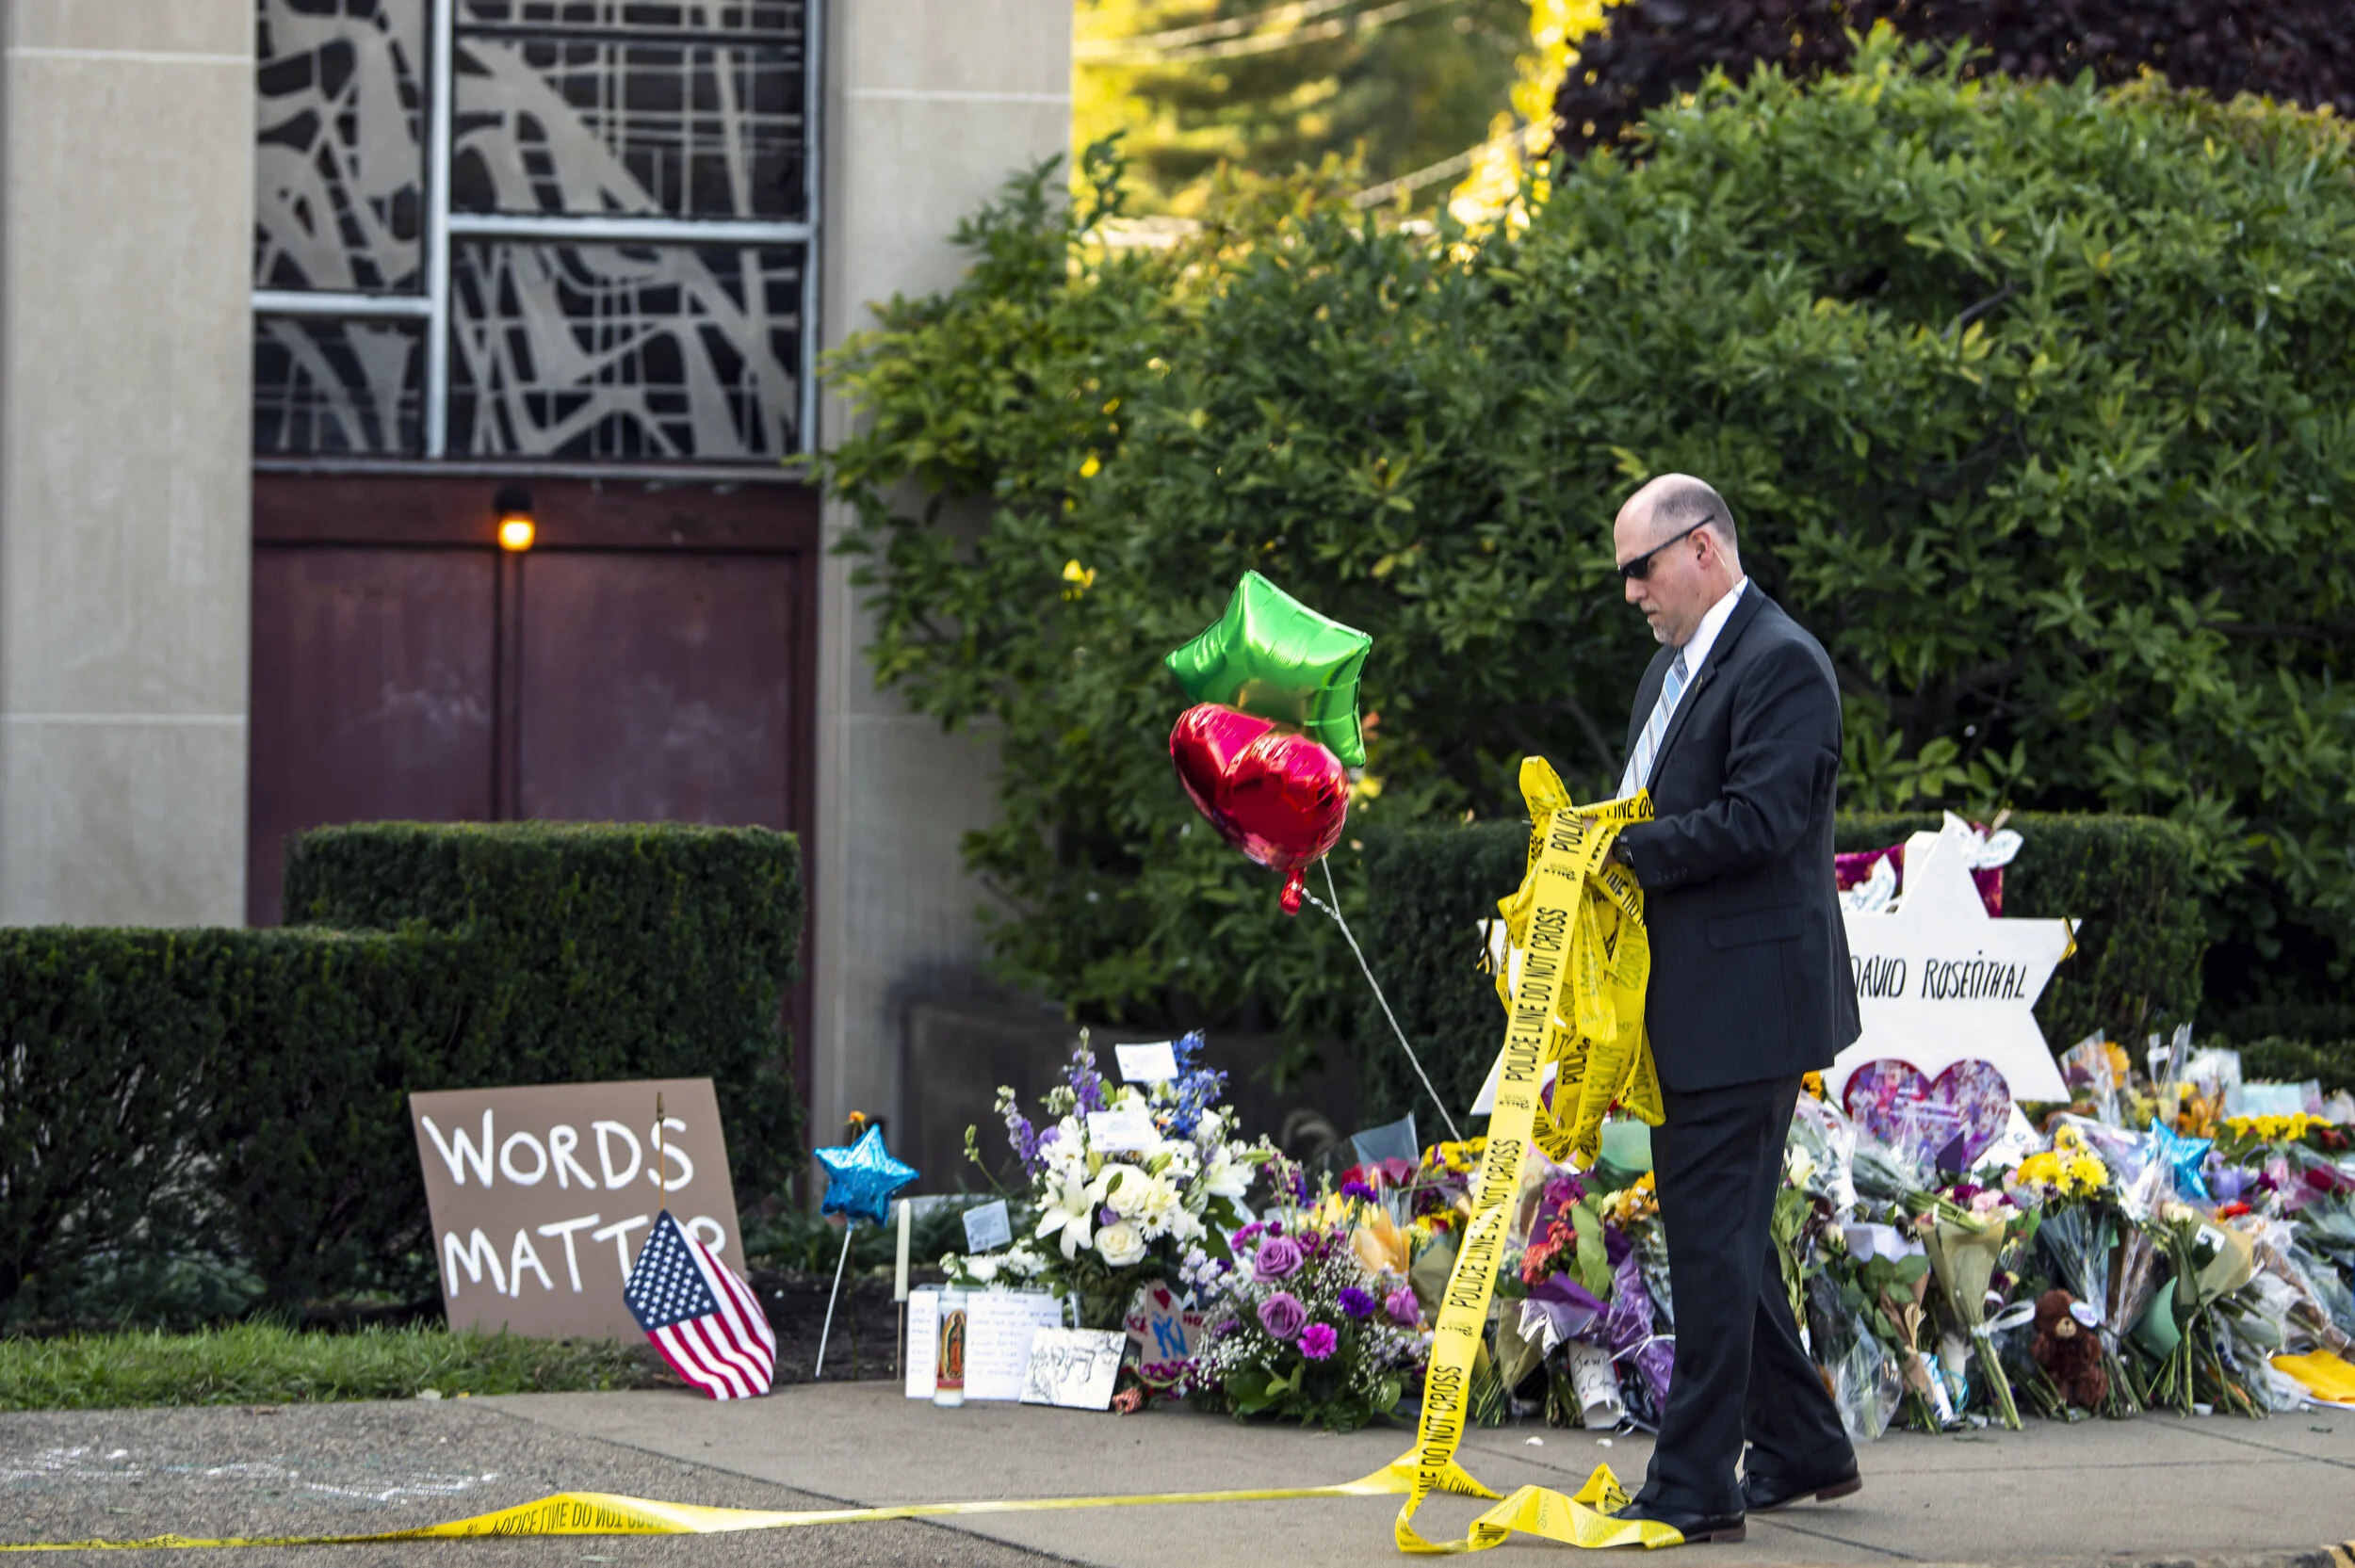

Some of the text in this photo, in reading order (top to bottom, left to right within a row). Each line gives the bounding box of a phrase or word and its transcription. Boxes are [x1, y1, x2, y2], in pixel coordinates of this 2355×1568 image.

[1530, 907, 1568, 951] CROSS
[1524, 952, 1558, 980] NOT
[1520, 982, 1552, 1001] DO
[1513, 1004, 1548, 1033] LINE
[1504, 1035, 1542, 1082] POLICE
[421, 1108, 693, 1191] WORDS
[1485, 1139, 1520, 1181] CROSS
[1478, 1186, 1511, 1210] NOT
[444, 1214, 725, 1298] MATT
[1465, 1235, 1496, 1261] LINE
[1449, 1264, 1488, 1310] POLICE
[1428, 1366, 1463, 1411] CROSS
[1423, 1414, 1457, 1445] NOT
[1421, 1447, 1452, 1467] DO
